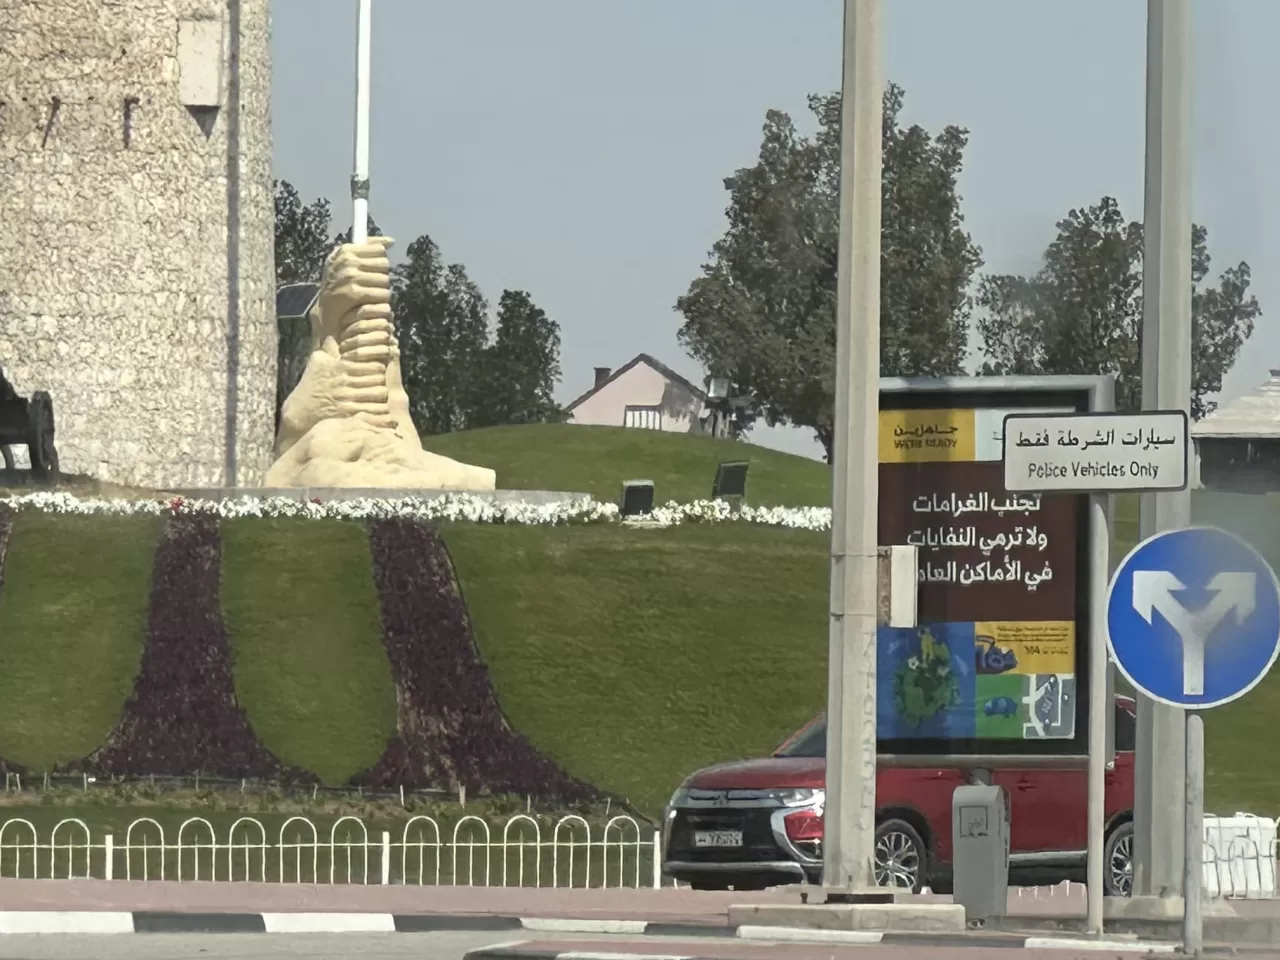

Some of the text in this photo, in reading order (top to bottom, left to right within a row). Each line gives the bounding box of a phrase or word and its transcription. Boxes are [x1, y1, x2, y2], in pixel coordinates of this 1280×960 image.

[1015, 429, 1049, 447] فقط
[1057, 429, 1115, 451] الشرطة
[1121, 428, 1176, 451] سيارات
[1028, 461, 1159, 479] Police Vehicles Only
[913, 492, 1043, 517] تجنب الغرامات
[907, 526, 1048, 555] ولا ترمي النفايات
[917, 555, 1053, 590] في الأماكن العام
